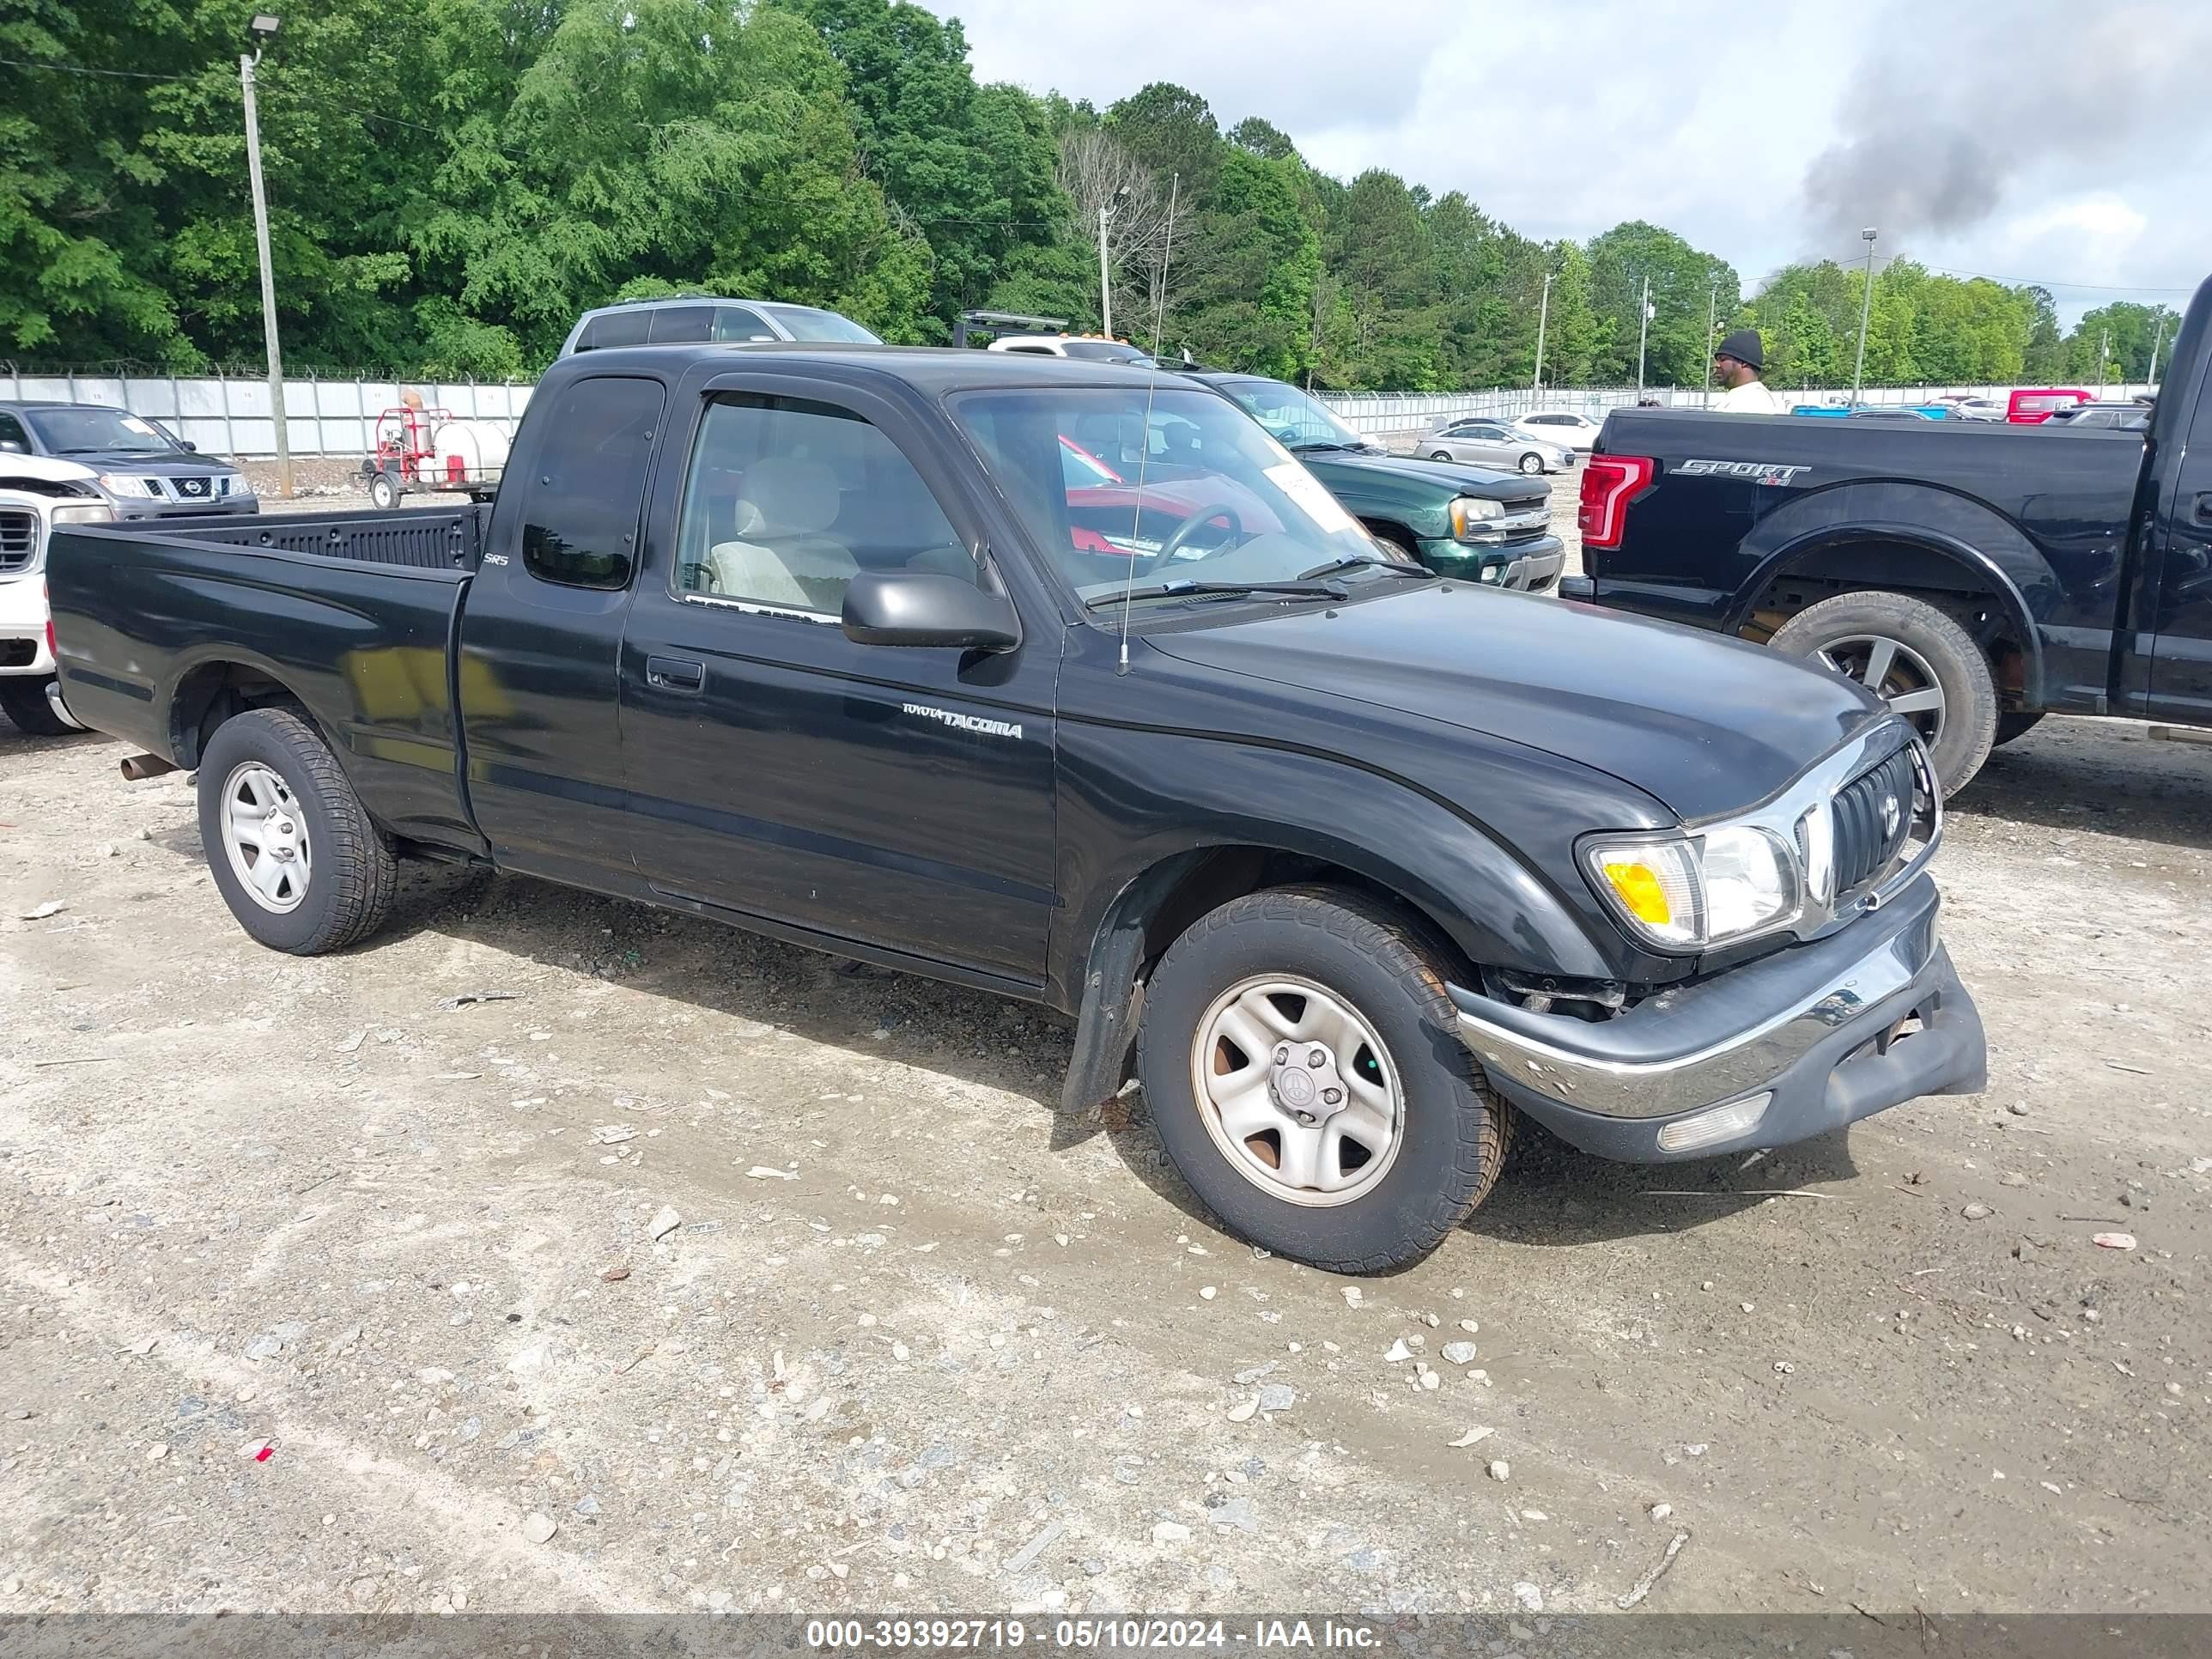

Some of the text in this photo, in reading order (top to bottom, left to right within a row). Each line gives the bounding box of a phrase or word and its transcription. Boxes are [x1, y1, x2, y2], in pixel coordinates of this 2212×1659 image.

[1668, 459, 1813, 479] SPORT
[902, 703, 1022, 739] TOYOTA TACOMA
